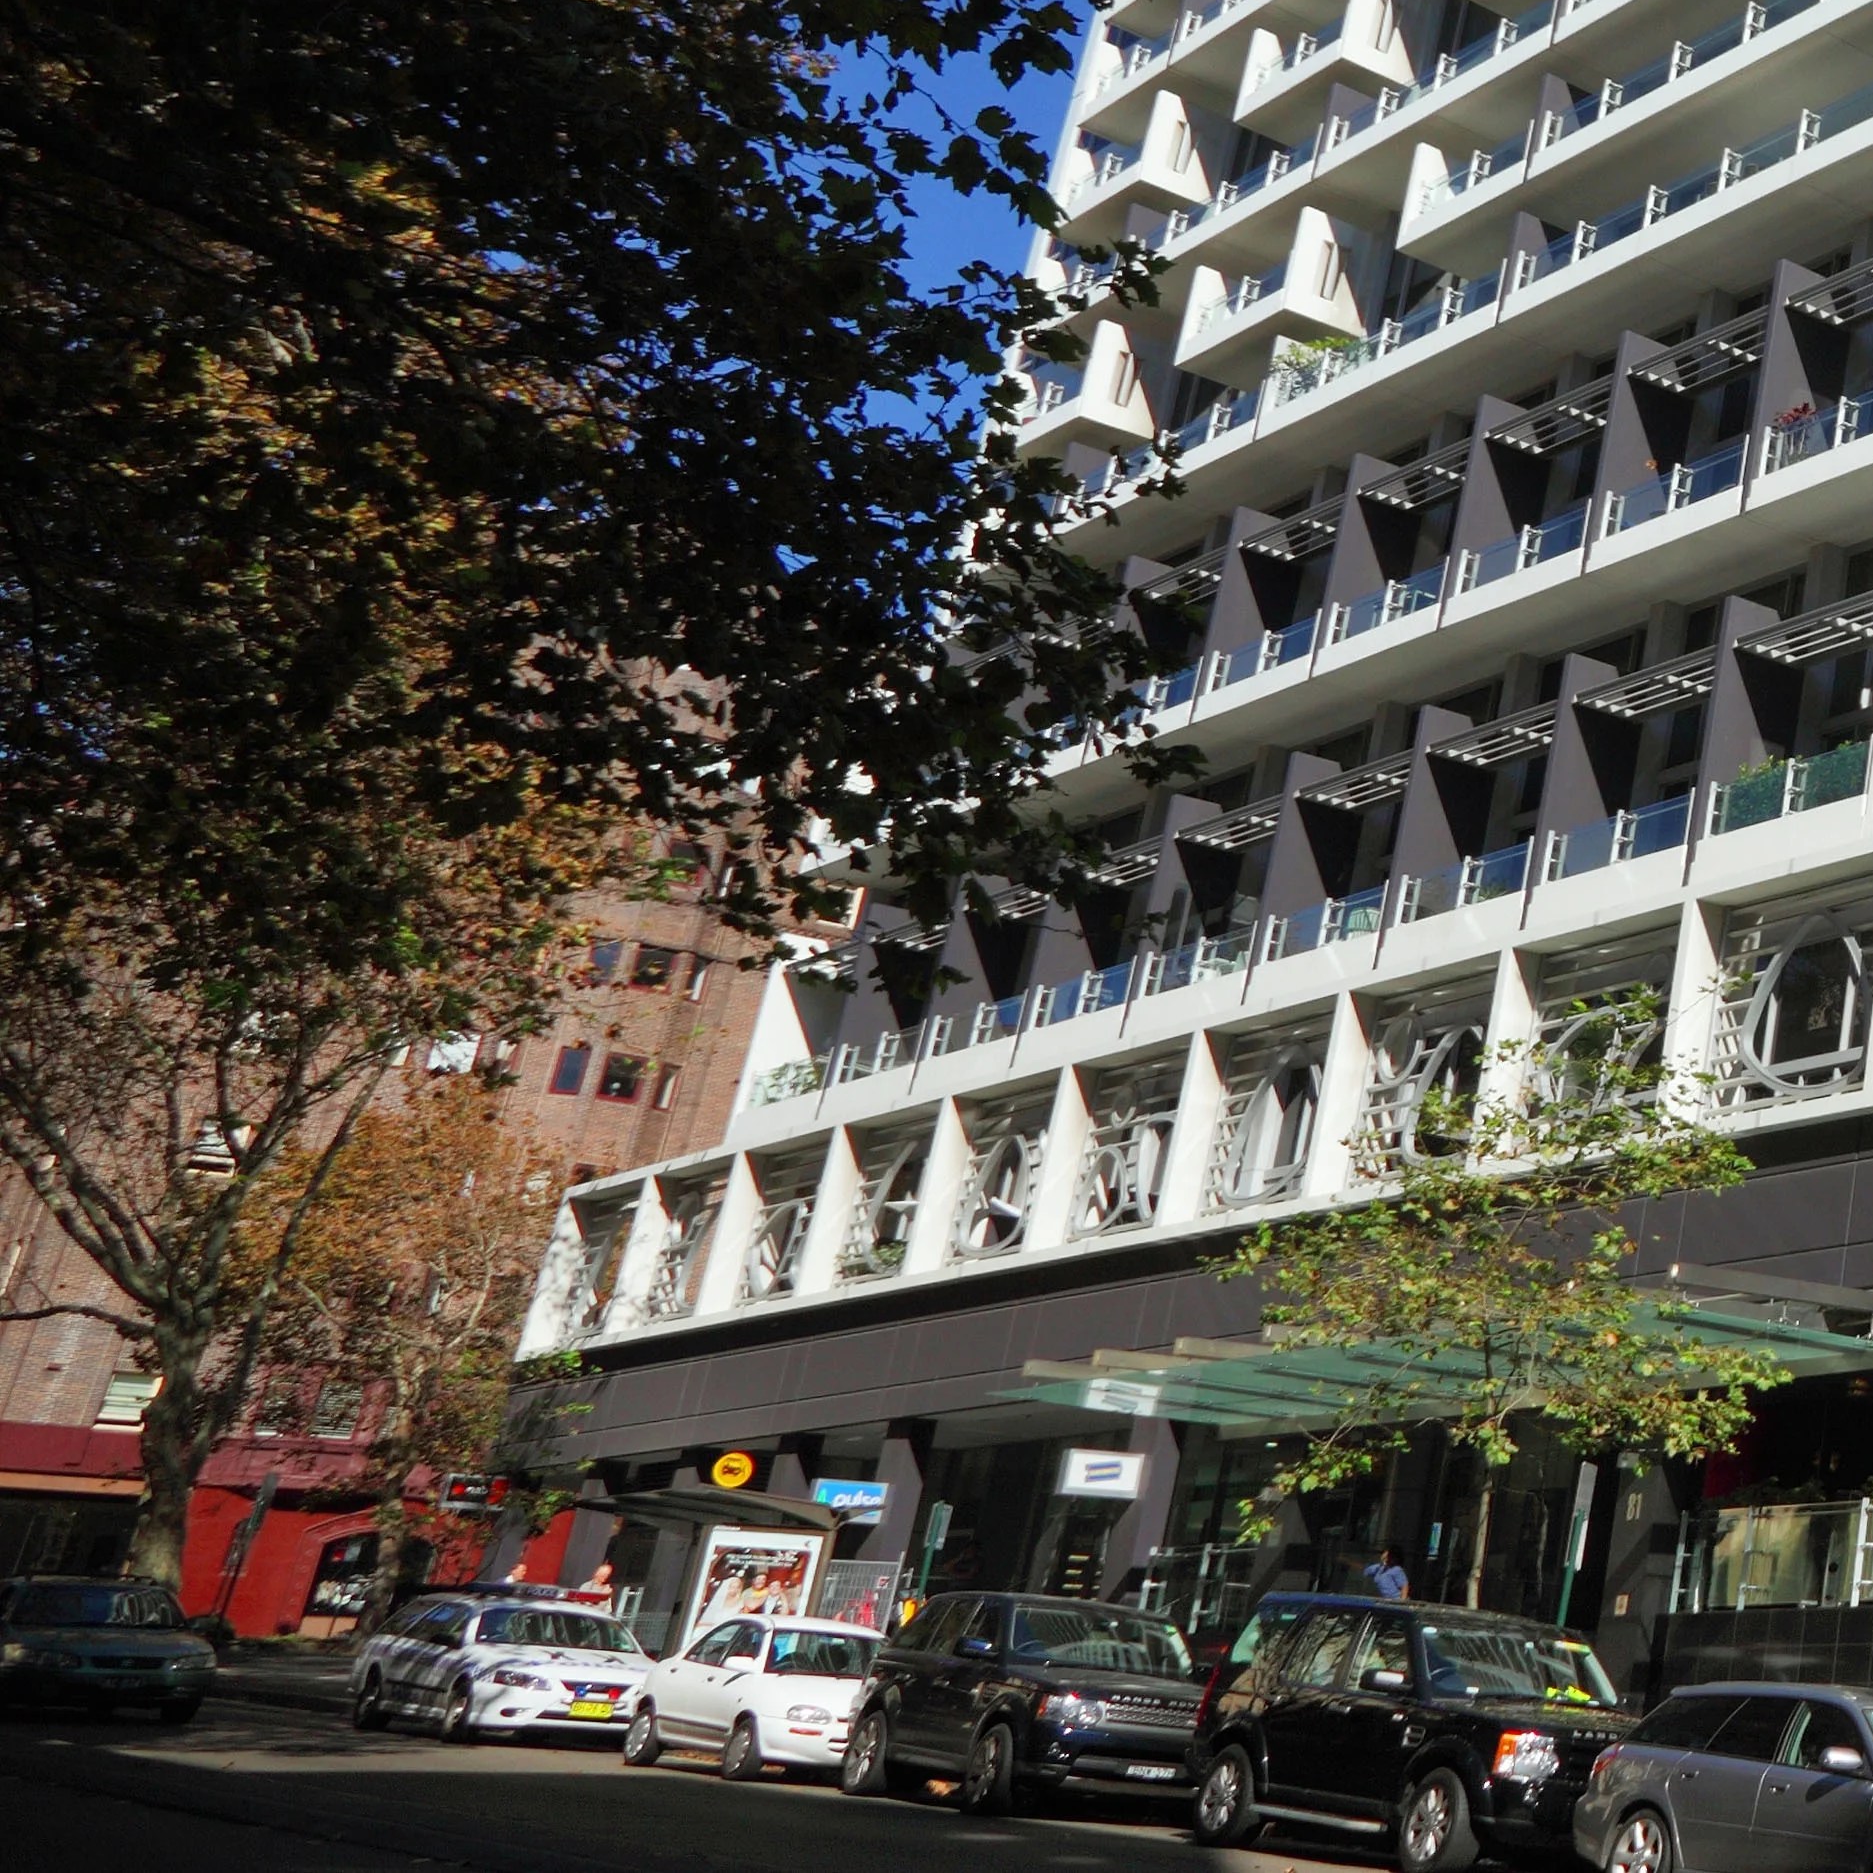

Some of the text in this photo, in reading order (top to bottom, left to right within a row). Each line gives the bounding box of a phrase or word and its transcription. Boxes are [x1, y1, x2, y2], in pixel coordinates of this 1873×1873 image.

[1626, 1492, 1642, 1521] 81
[1111, 1694, 1161, 1706] RANGE
[1573, 1730, 1618, 1740] LAND
